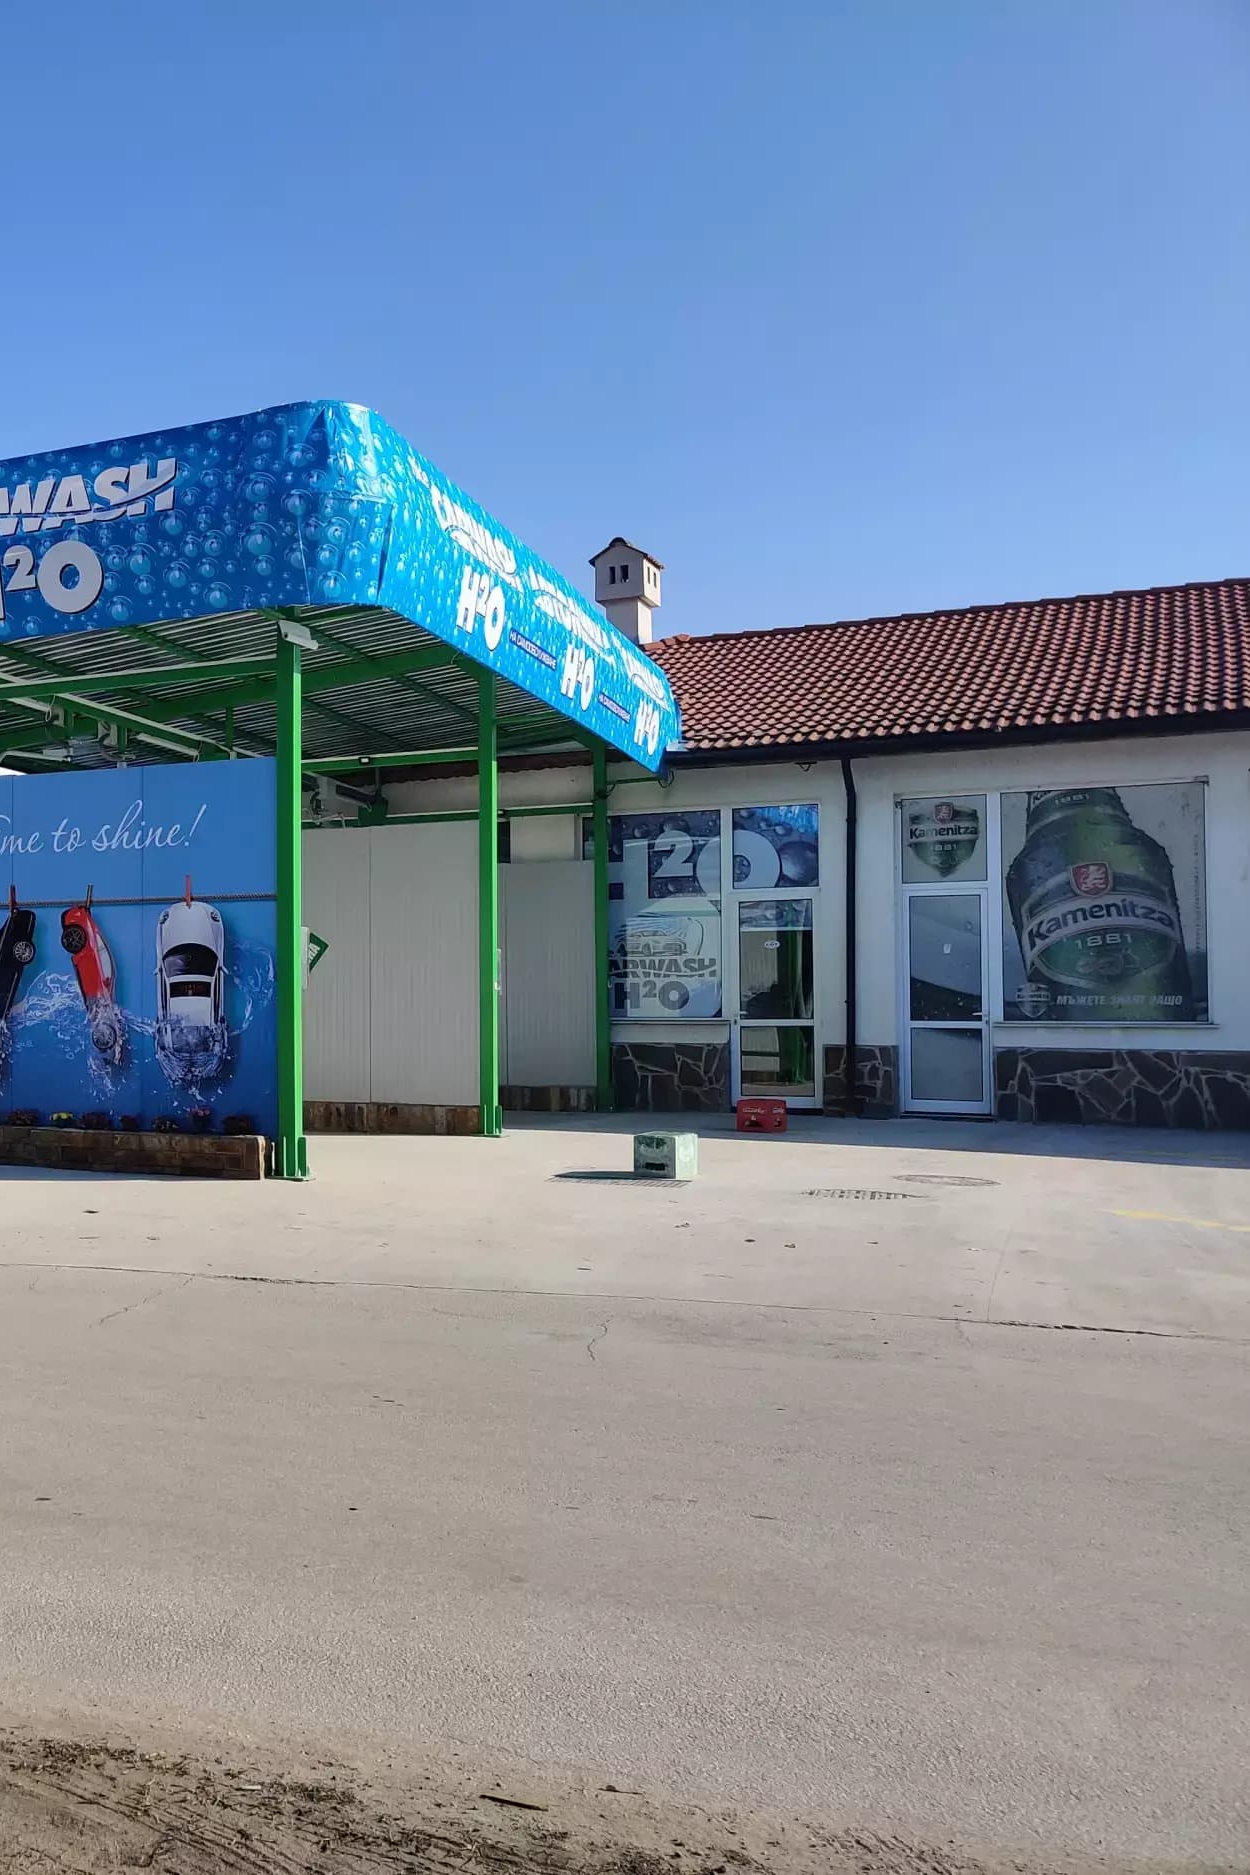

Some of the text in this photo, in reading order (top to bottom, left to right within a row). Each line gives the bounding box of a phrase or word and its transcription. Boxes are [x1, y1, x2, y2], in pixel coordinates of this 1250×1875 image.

[456, 564, 505, 652] H2O
[51, 818, 86, 853] to
[92, 799, 207, 852] shine!
[909, 824, 978, 840] Kamenitza
[1028, 899, 1175, 950] Kamenitza
[1074, 932, 1133, 949] 1881
[609, 956, 717, 980] ARWASH
[614, 980, 690, 1011] H2O
[1056, 995, 1106, 1005] МЪЖЕТЕ
